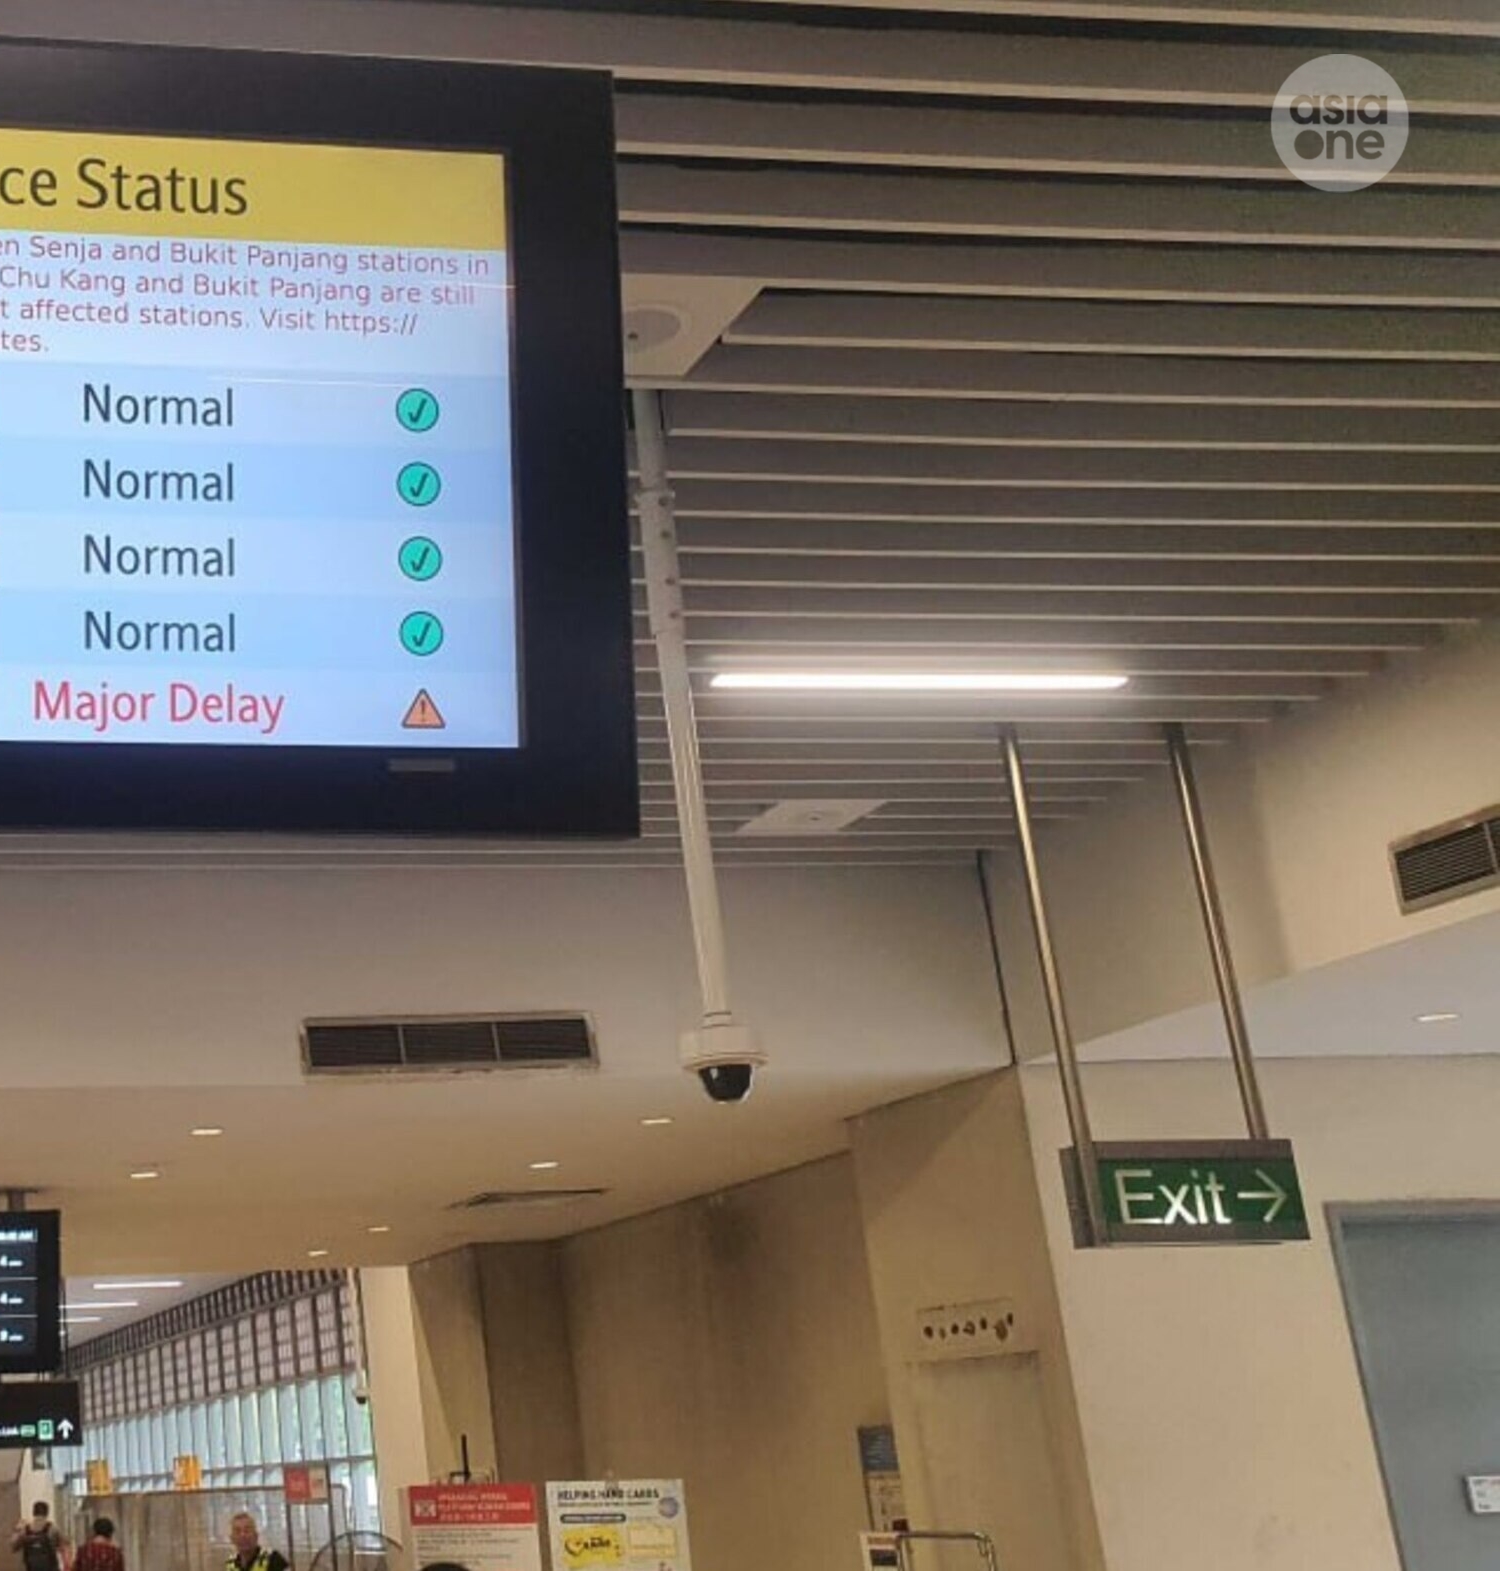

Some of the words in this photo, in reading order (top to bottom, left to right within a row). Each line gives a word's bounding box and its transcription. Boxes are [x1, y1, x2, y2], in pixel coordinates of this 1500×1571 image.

[76, 158, 248, 216] Status
[29, 235, 102, 264] Senja
[111, 240, 161, 263] and
[170, 241, 237, 266] Bukit
[247, 244, 348, 275] Panjang
[357, 251, 459, 275] stations
[467, 253, 489, 276] in
[60, 268, 126, 298] Kang
[135, 274, 184, 294] and
[193, 273, 259, 297] Bukit
[270, 276, 372, 307] Panjang
[380, 285, 421, 304] are
[430, 285, 475, 306] still
[20, 298, 129, 324] affected
[139, 304, 250, 329] stations.
[259, 307, 315, 331] Visit
[325, 309, 419, 337] https://
[83, 383, 233, 427] Normal
[84, 458, 234, 502] Normal
[84, 534, 235, 577] Normal
[84, 610, 236, 653] Normal
[34, 680, 156, 733] Major
[169, 682, 285, 735] Delay
[1114, 1168, 1232, 1226] Exit
